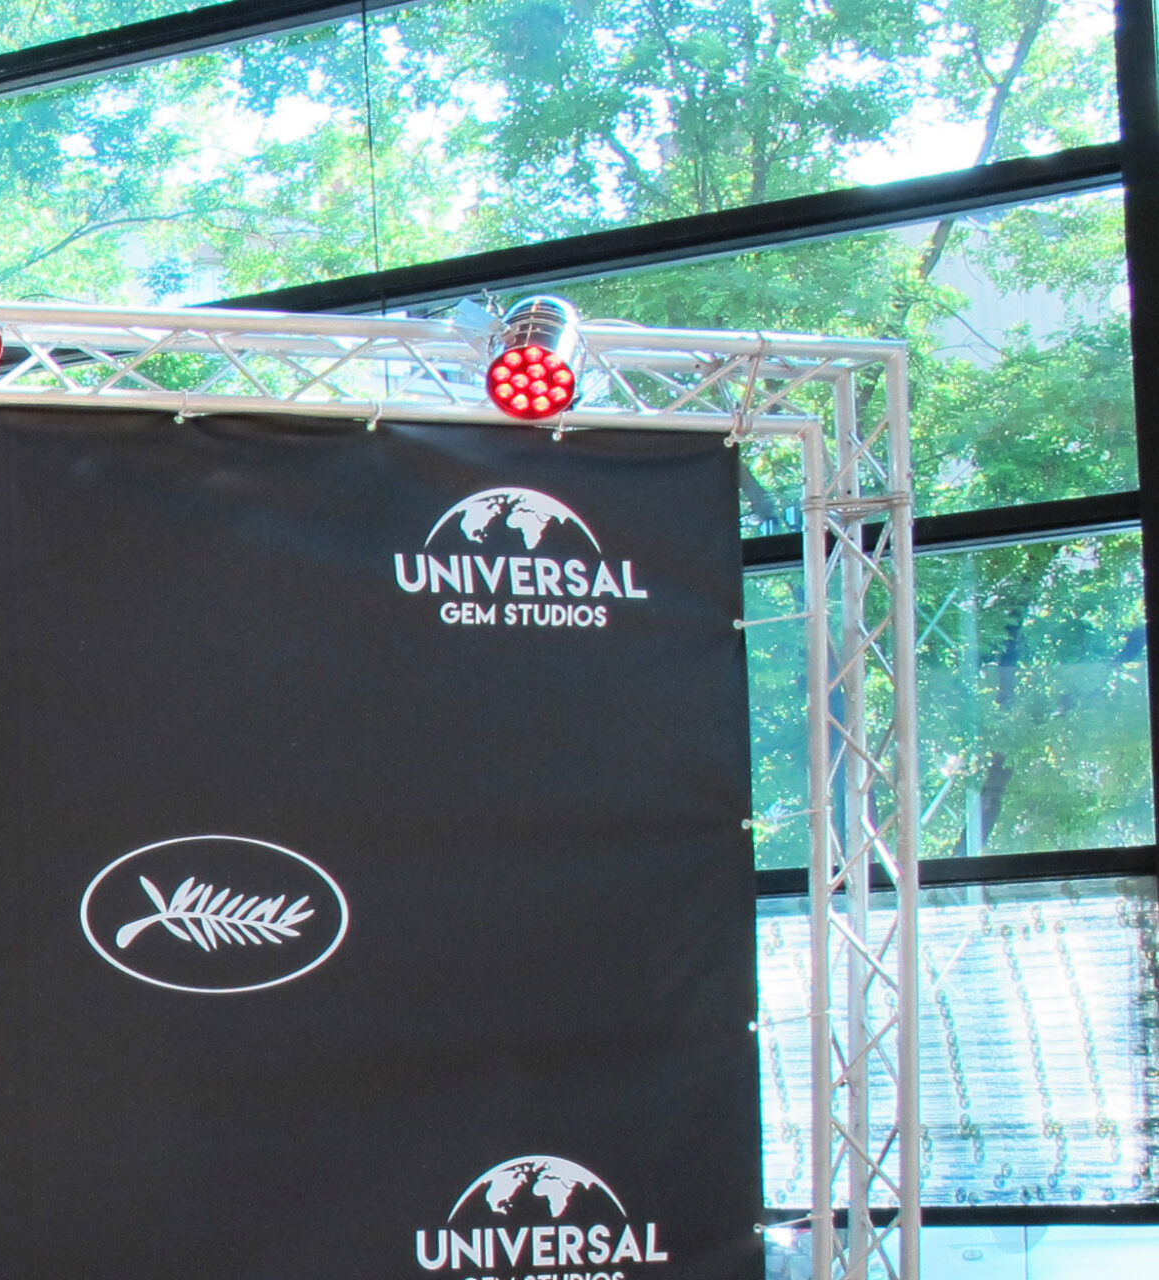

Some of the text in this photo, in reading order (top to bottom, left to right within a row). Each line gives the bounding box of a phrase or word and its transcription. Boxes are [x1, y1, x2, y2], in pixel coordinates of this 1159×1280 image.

[394, 553, 649, 599] UNIVERSAL
[440, 602, 607, 627] GEM STUDIOS
[415, 1222, 669, 1270] UNIVERSAL
